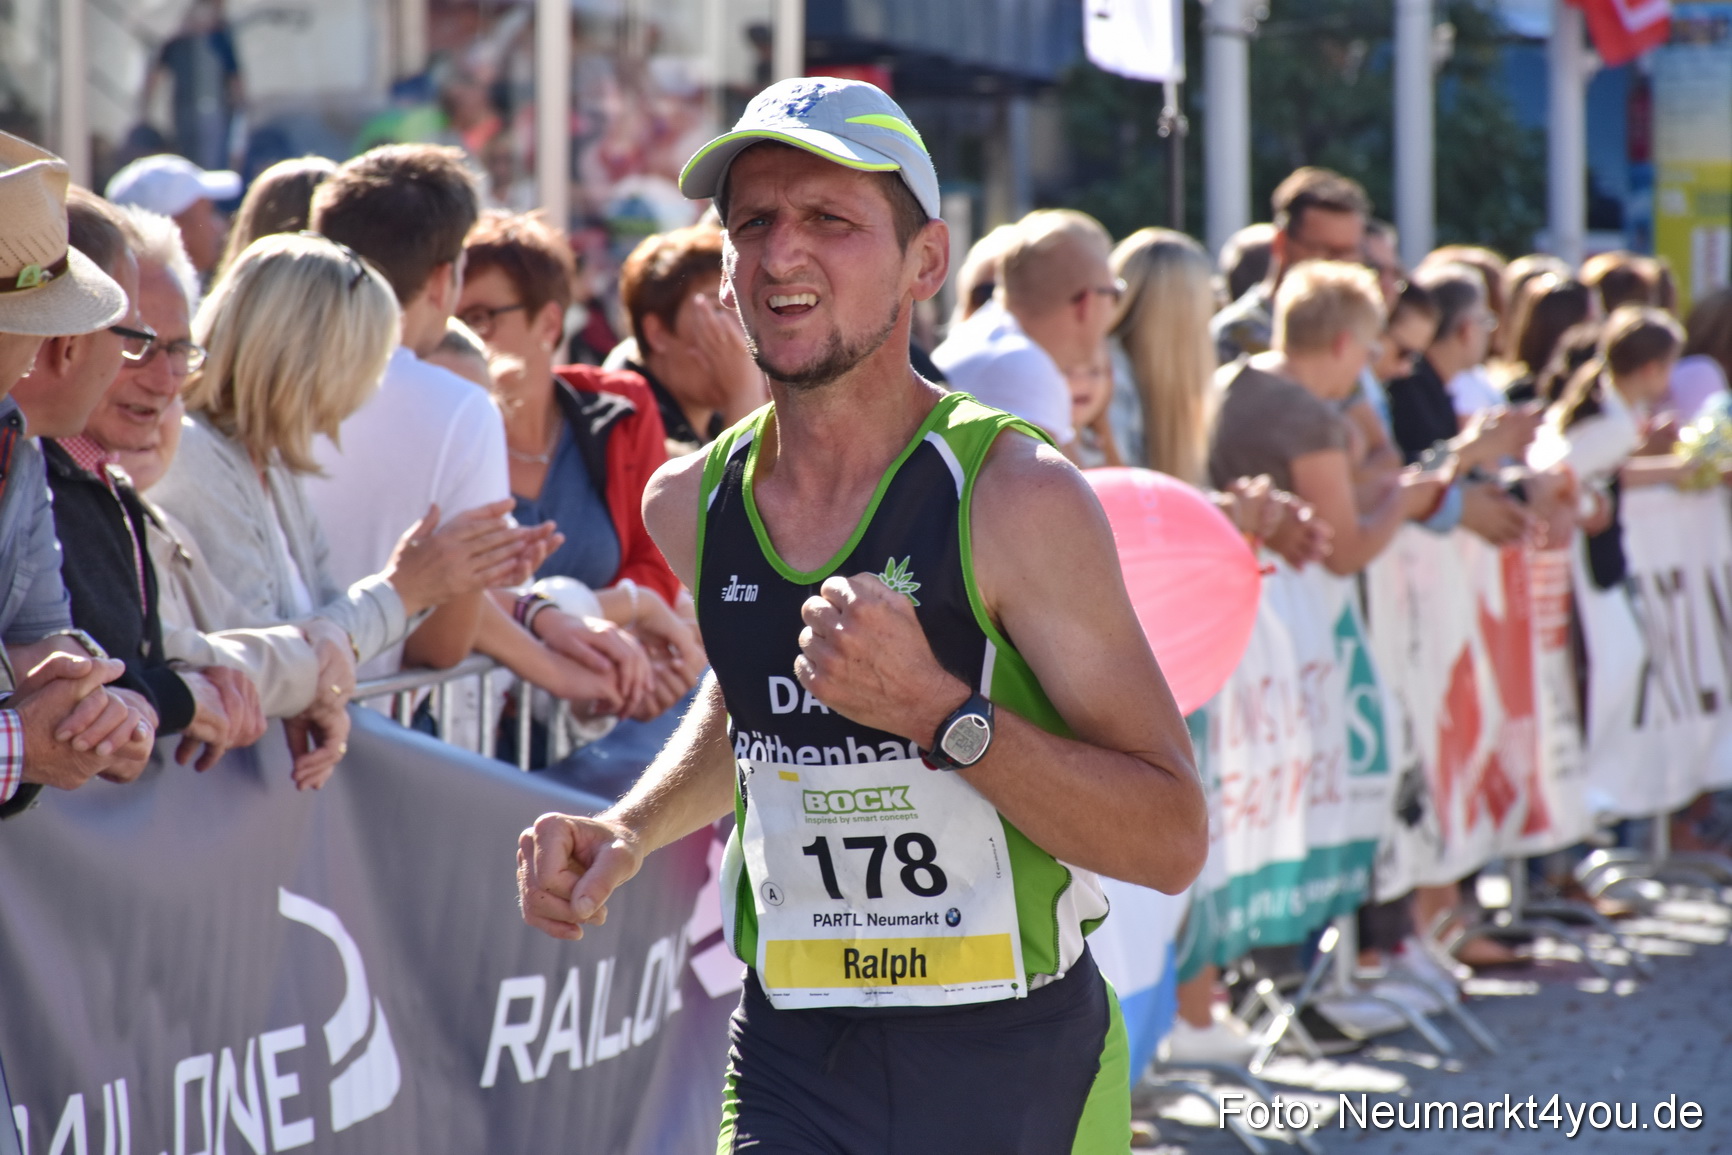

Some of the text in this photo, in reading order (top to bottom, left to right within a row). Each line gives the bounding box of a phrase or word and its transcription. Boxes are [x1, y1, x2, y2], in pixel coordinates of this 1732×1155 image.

[768, 676, 840, 715] DA
[803, 785, 916, 815] BOCK
[805, 812, 919, 825] inspired by smart concepts
[802, 832, 948, 900] 178
[769, 888, 778, 901] A
[813, 911, 940, 928] PARTL Neumarkt
[843, 947, 928, 985] Ralph
